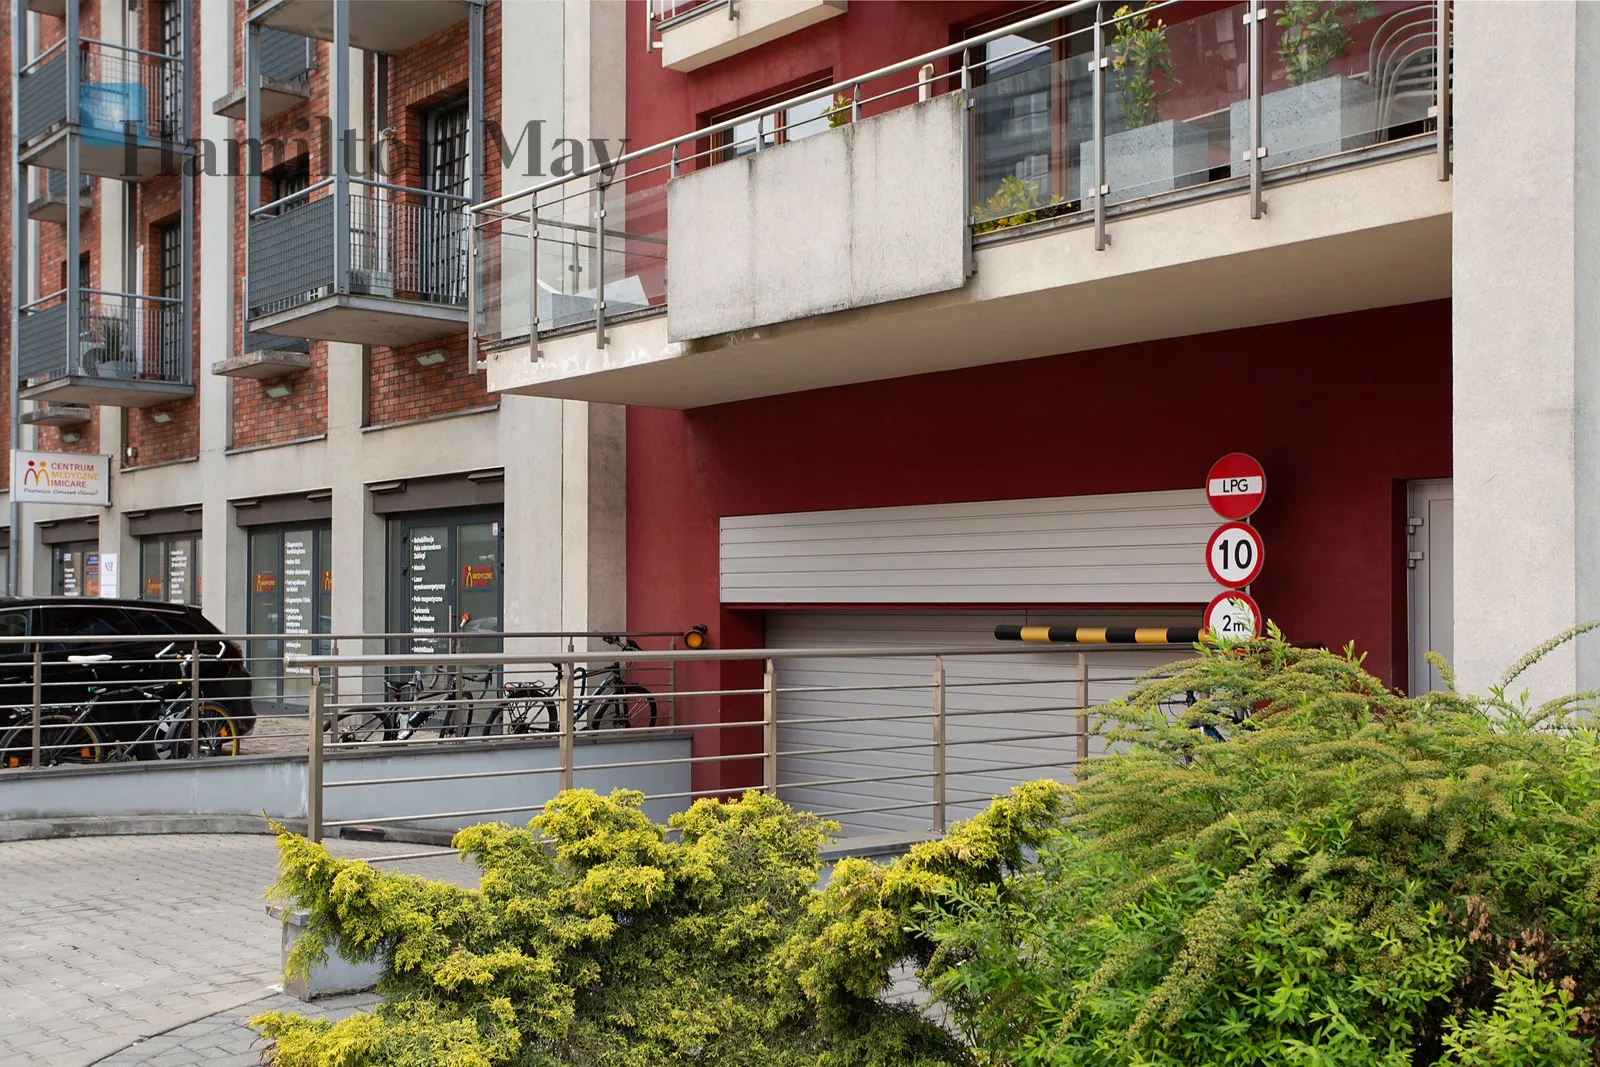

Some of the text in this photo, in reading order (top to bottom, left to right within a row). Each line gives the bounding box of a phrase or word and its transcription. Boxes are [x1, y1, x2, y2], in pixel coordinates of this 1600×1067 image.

[51, 462, 94, 472] CENTRUM
[51, 471, 99, 481] MEDYCZNE
[51, 479, 87, 488] IMICARE
[1222, 478, 1249, 493] LPG
[1218, 538, 1253, 570] 10
